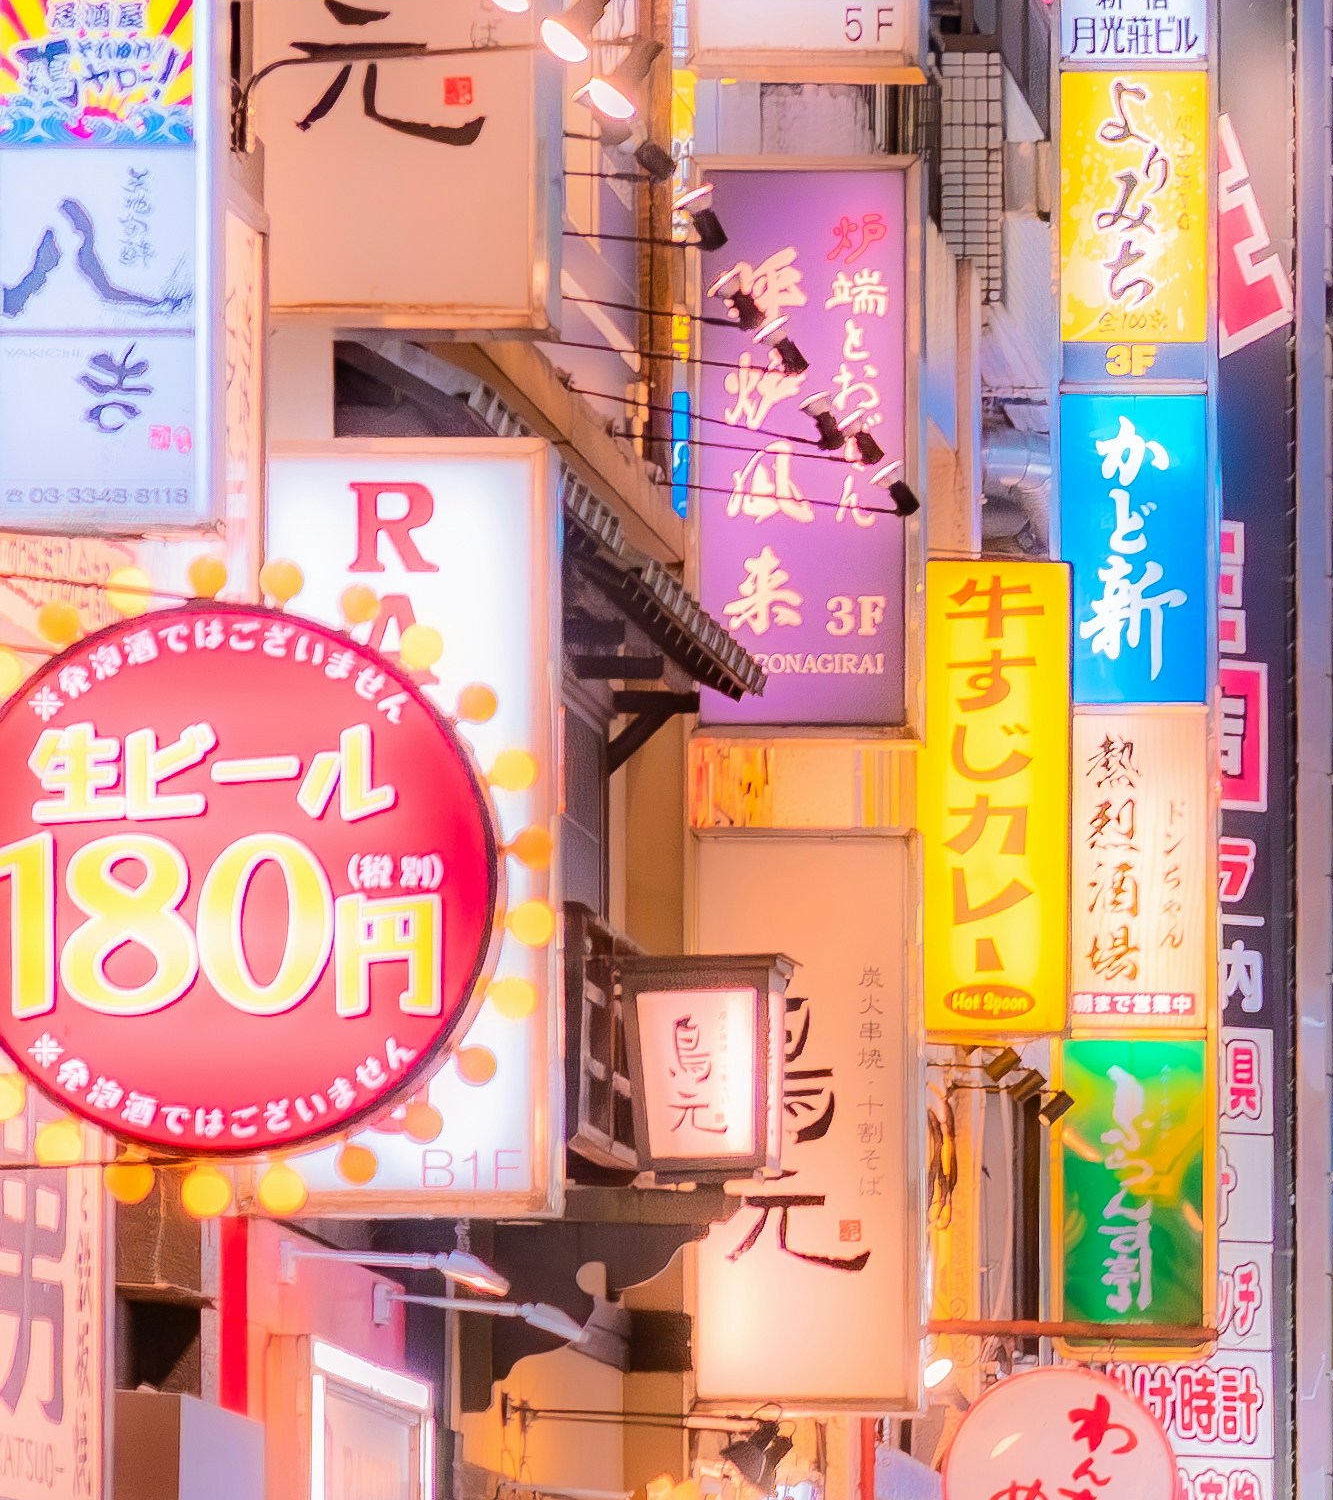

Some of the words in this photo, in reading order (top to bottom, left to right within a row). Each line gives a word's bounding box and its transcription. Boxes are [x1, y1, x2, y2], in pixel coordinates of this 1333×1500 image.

[844, 8, 896, 43] 5F
[1096, 80, 1171, 308] よりみち
[1105, 344, 1157, 378] 3F
[1080, 415, 1188, 683] かど新
[826, 596, 886, 636] 3F
[27, 721, 399, 824] 生ビール
[942, 574, 1045, 973] 牛すじカレー
[1084, 732, 1143, 983] 熱烈酒場
[951, 984, 980, 1011] Hot
[982, 984, 1029, 1013] Spoon
[1073, 992, 1193, 1017] 朝まで営業中
[668, 1013, 728, 1134] 鳥元
[421, 1150, 525, 1190] B1F
